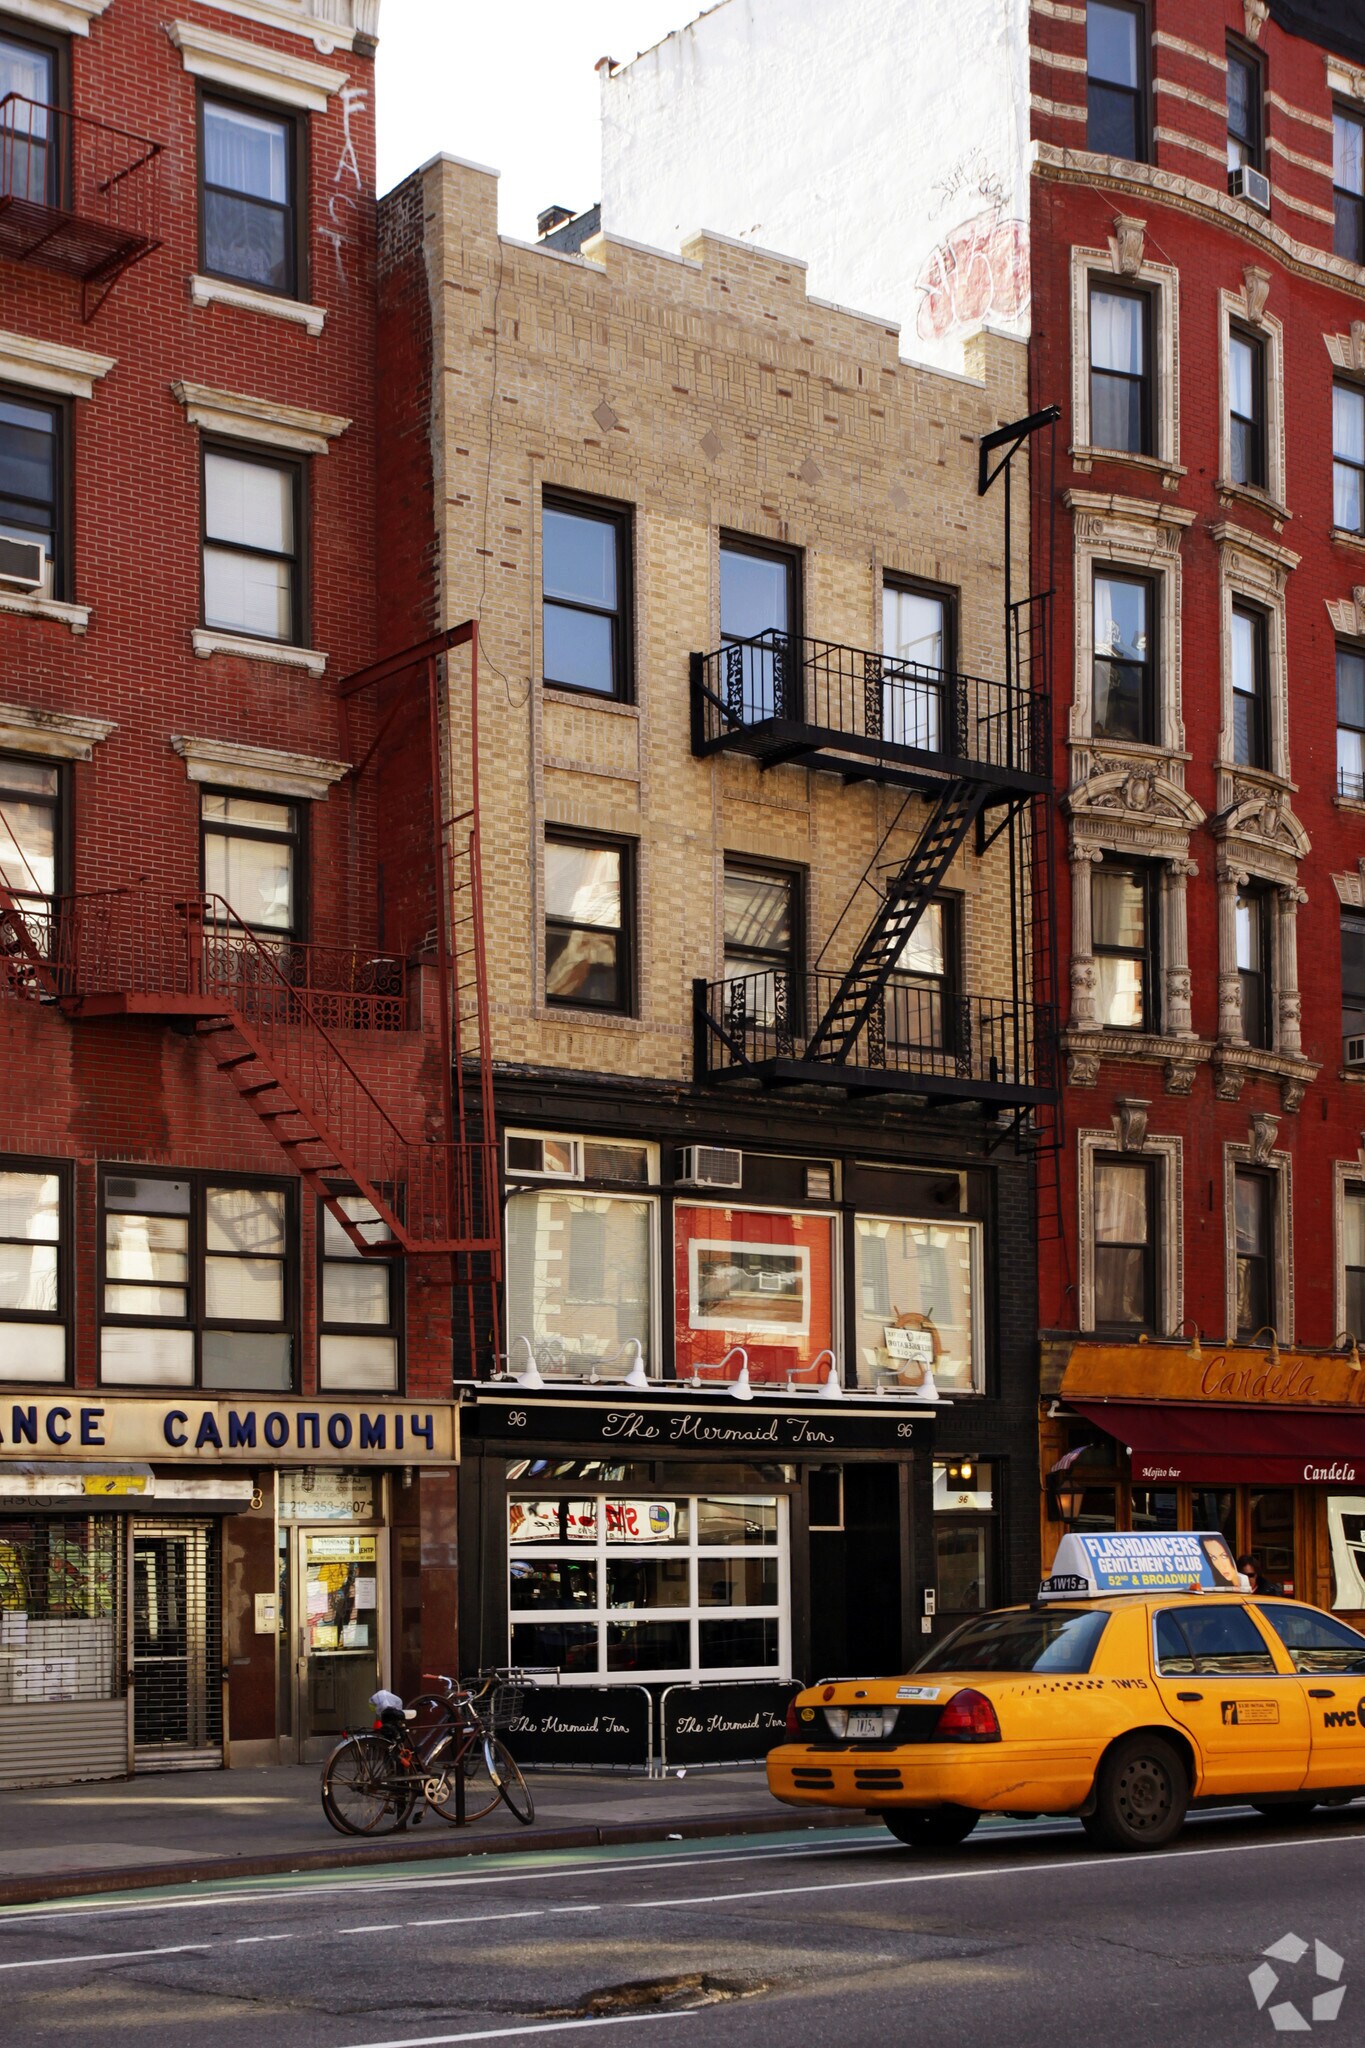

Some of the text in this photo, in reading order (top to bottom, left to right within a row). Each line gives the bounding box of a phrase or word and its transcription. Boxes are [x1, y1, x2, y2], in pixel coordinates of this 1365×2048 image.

[1201, 1356, 1319, 1398] Candela
[0, 1406, 105, 1446] NCE
[507, 1411, 527, 1428] 96
[601, 1412, 834, 1444] The Mermaid Inn
[163, 1410, 434, 1450] САМОПОМІЧ
[897, 1423, 914, 1438] 96
[1142, 1466, 1181, 1480] Mojito bar
[1303, 1462, 1356, 1481] Candela
[250, 1488, 263, 1509] 8
[958, 1495, 969, 1504] 96
[1085, 1537, 1202, 1558] FLASHDANCERS
[1097, 1555, 1203, 1574] GENTLEMEN'S CLUB
[1053, 1577, 1077, 1590] 1W15
[1132, 1575, 1140, 1586] &
[1142, 1574, 1201, 1586] BROADWAY
[1111, 1679, 1148, 1688] 1W15
[509, 1716, 630, 1733] The Mermaid Inn
[676, 1717, 704, 1733] The
[707, 1713, 760, 1733] Mermaid
[762, 1711, 787, 1728] Inn
[1323, 1711, 1356, 1728] NYC
